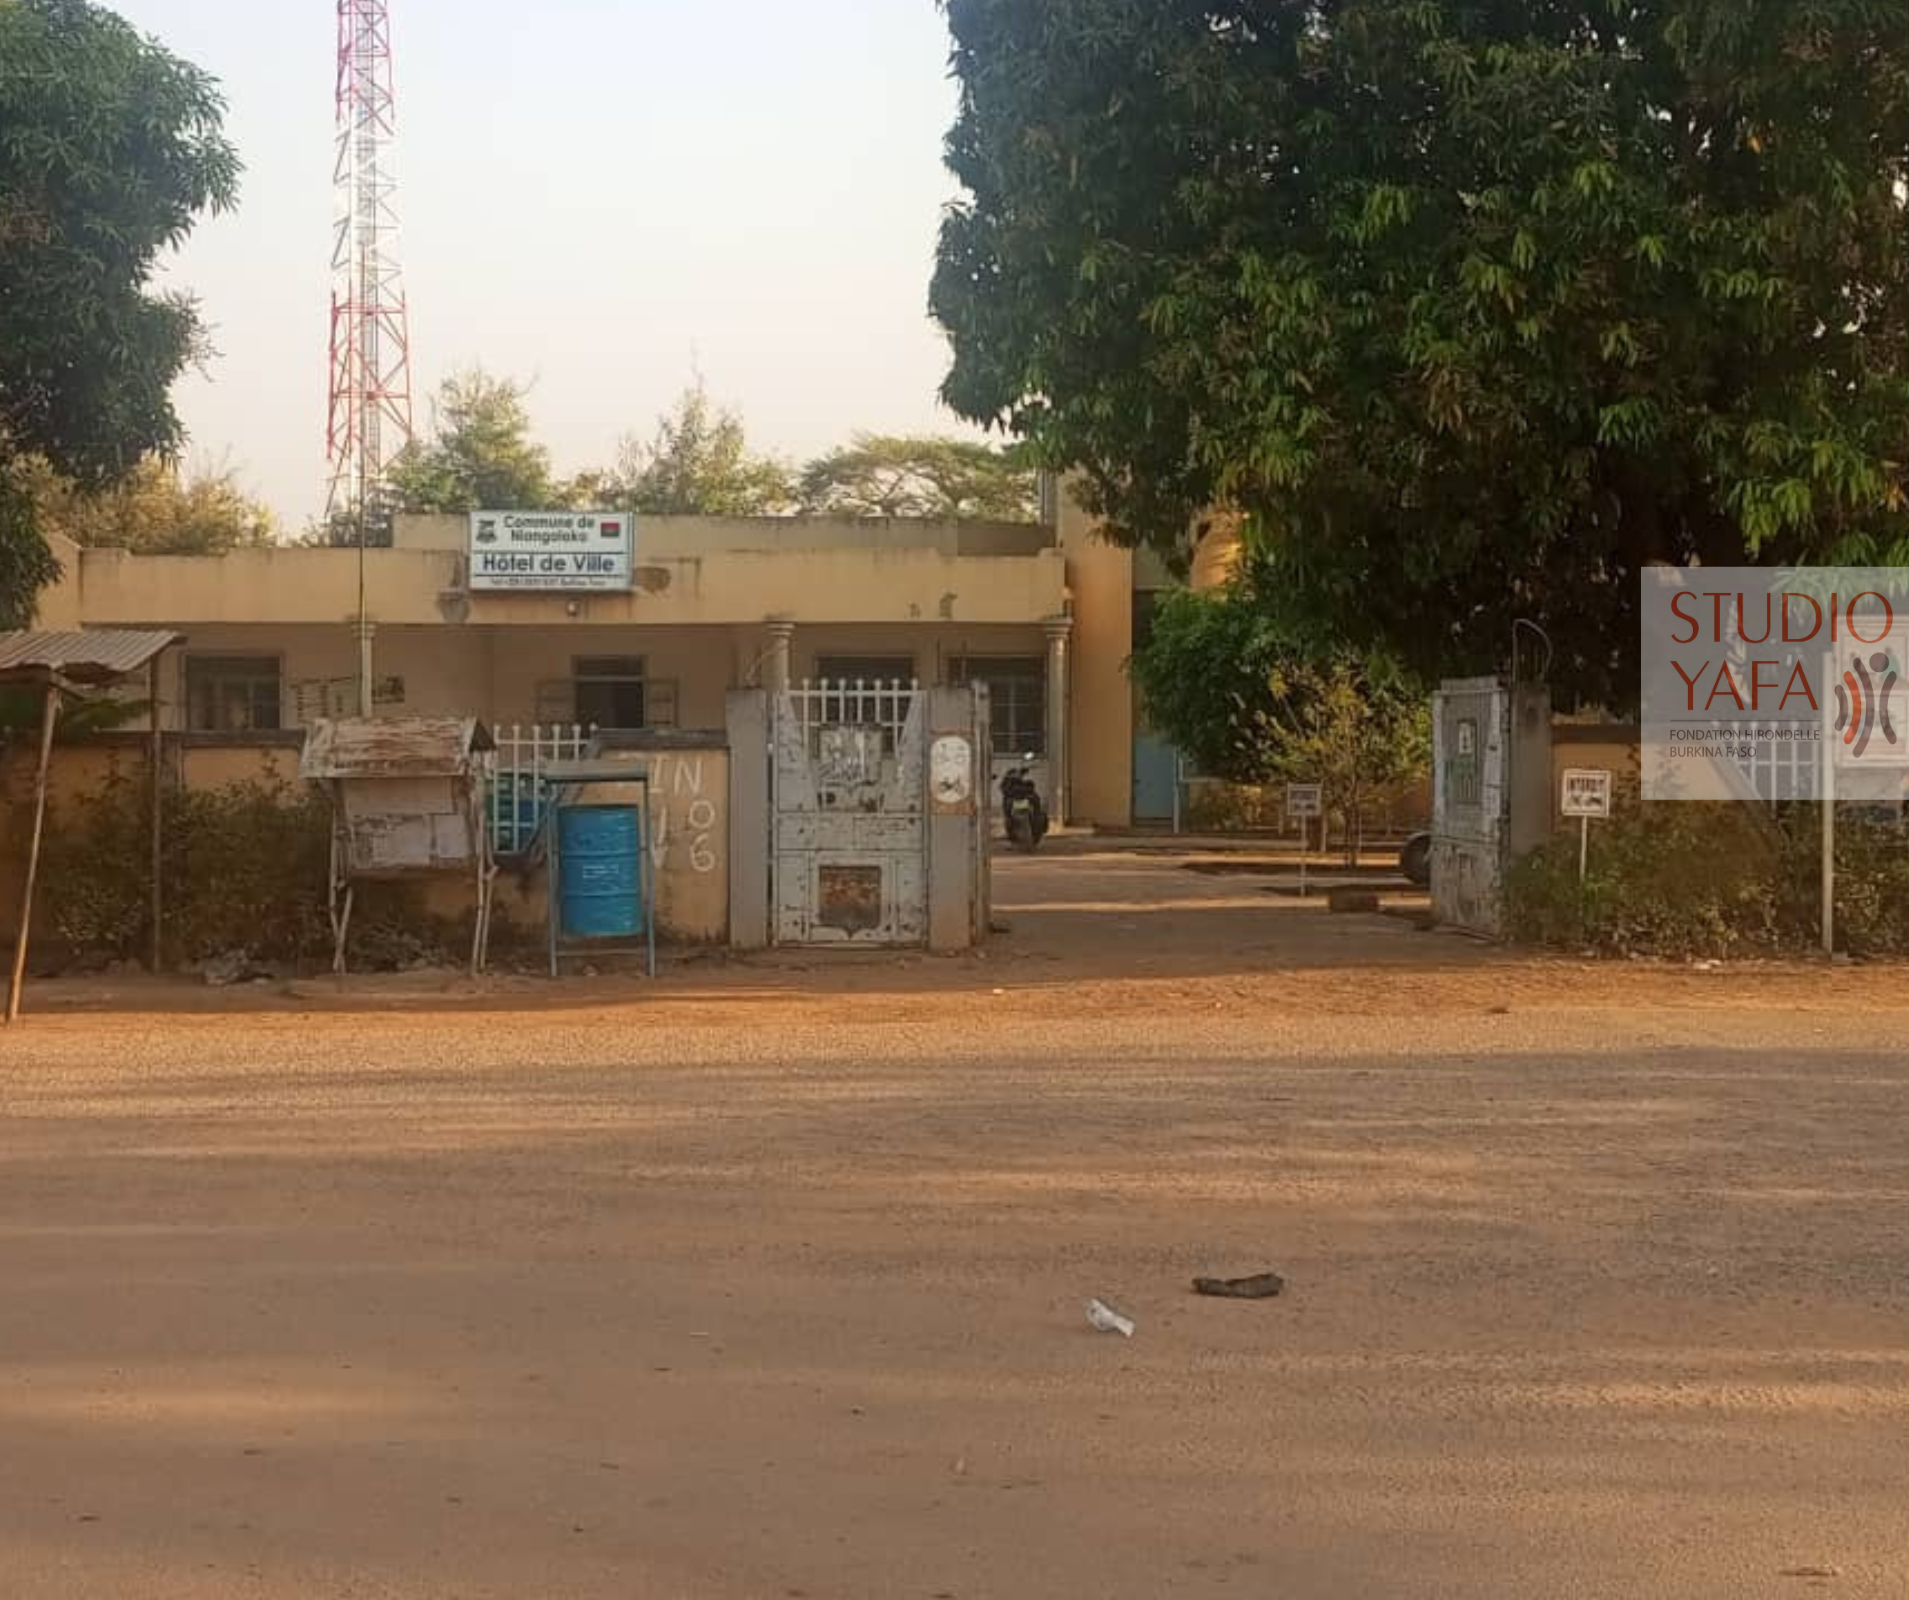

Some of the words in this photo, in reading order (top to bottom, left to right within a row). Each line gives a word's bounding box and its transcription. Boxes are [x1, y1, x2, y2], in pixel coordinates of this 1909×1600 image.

[503, 515, 574, 528] Commune
[483, 553, 534, 571] Hôtel
[540, 554, 566, 571] de
[574, 555, 615, 571] Ville
